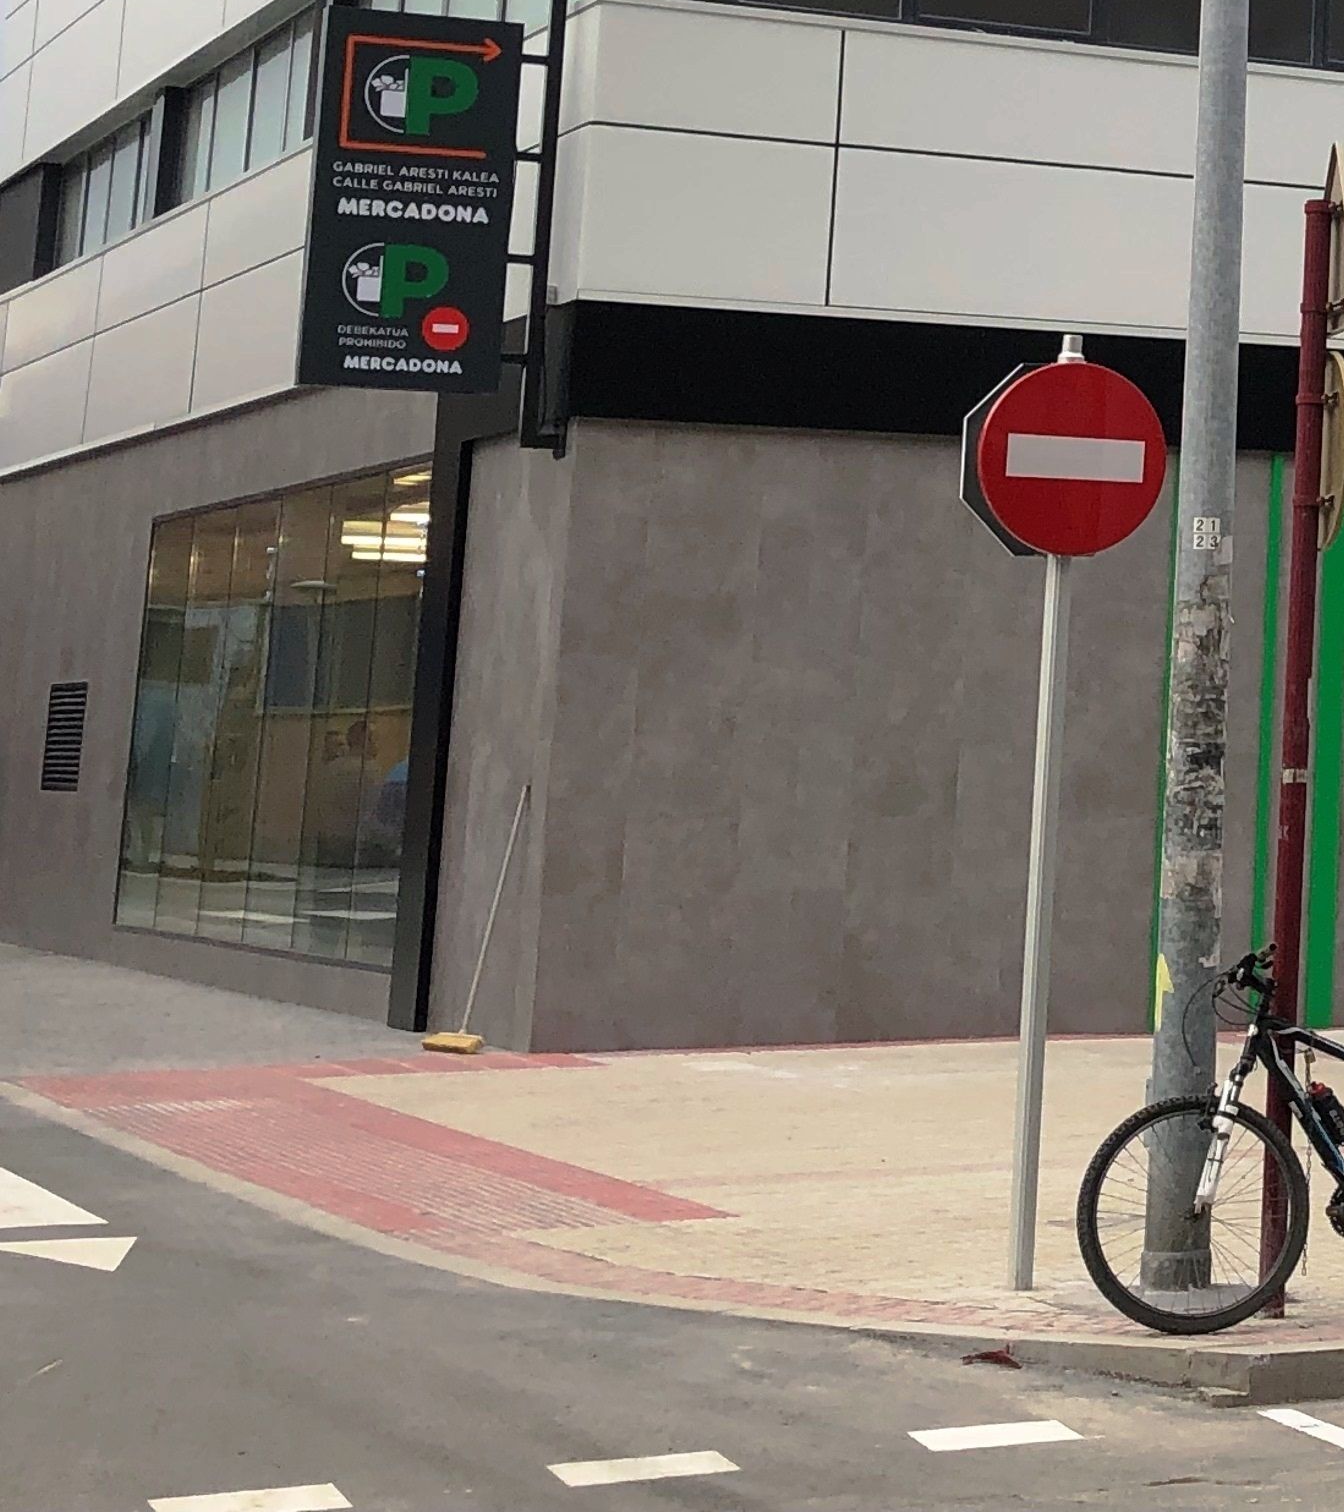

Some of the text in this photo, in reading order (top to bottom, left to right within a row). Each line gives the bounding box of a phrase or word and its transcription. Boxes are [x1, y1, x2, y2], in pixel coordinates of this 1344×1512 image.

[332, 161, 500, 183] GABRIEL ARESTI KALEA
[332, 176, 498, 198] CALLE GABRIEL ARESTI
[337, 196, 490, 224] MERCADONA
[338, 337, 407, 349] PROHIBIDO
[343, 355, 463, 375] MERCADONA
[1196, 536, 1219, 548] 23
